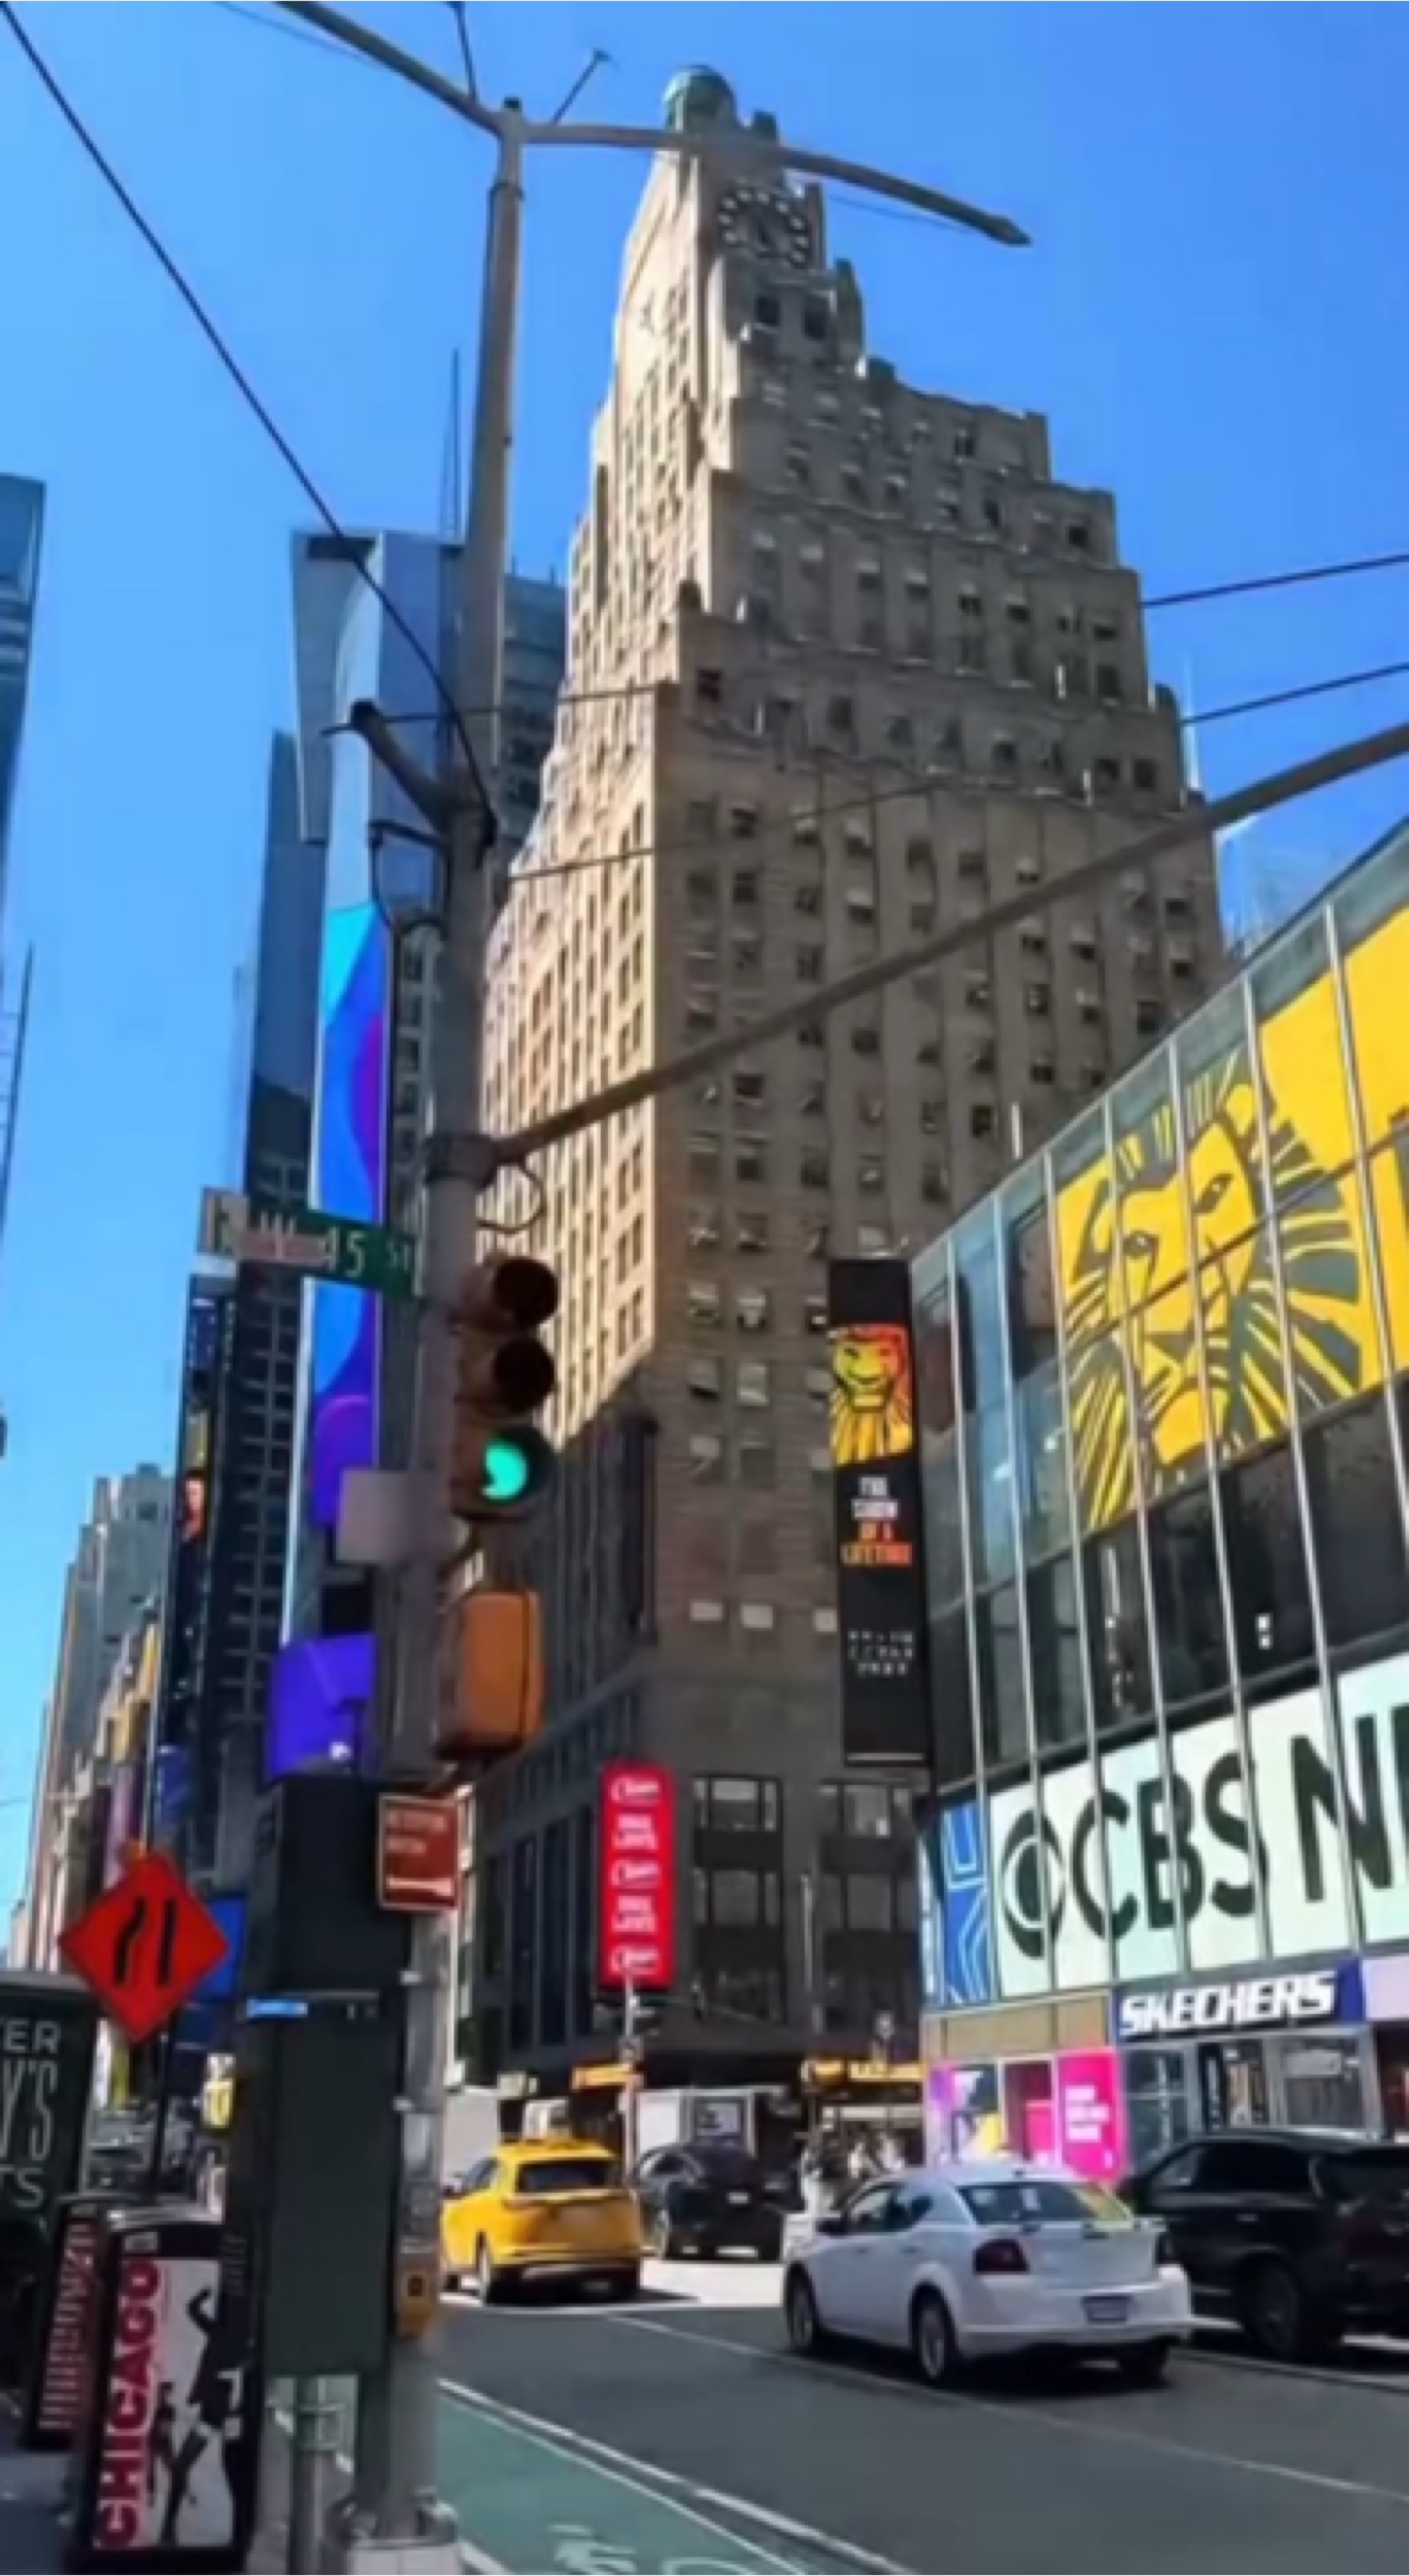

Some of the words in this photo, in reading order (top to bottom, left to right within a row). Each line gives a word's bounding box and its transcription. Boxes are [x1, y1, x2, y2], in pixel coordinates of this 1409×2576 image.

[1071, 1751, 1270, 1941] CBS
[1118, 1970, 1338, 2037] SKECHERS
[94, 2259, 160, 2547] CHICAGO
